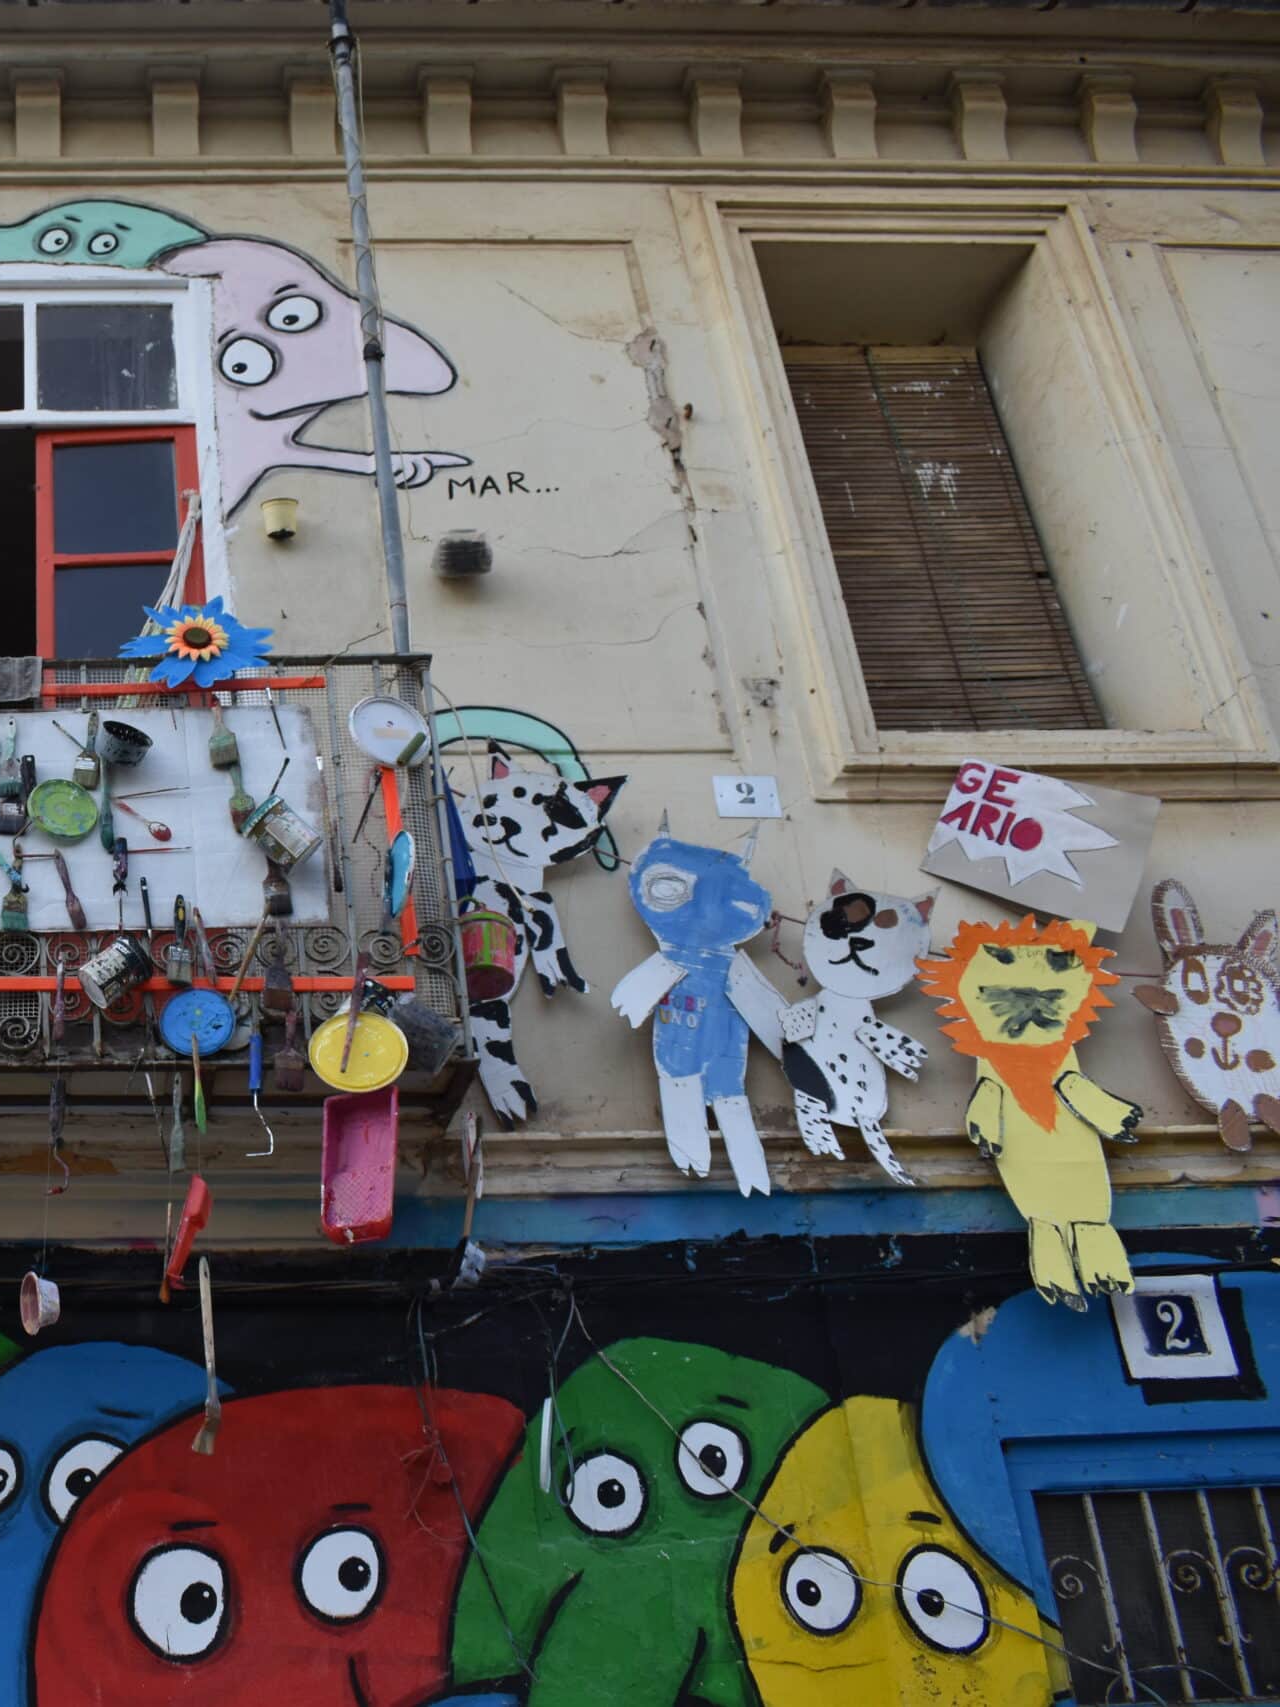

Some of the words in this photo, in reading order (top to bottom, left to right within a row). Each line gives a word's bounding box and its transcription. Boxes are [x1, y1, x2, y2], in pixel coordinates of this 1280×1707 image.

[448, 471, 560, 500] MAR...
[735, 782, 756, 804] 2
[954, 762, 1021, 807] GE
[940, 801, 1043, 851] ARIO
[1156, 1300, 1191, 1350] 2
